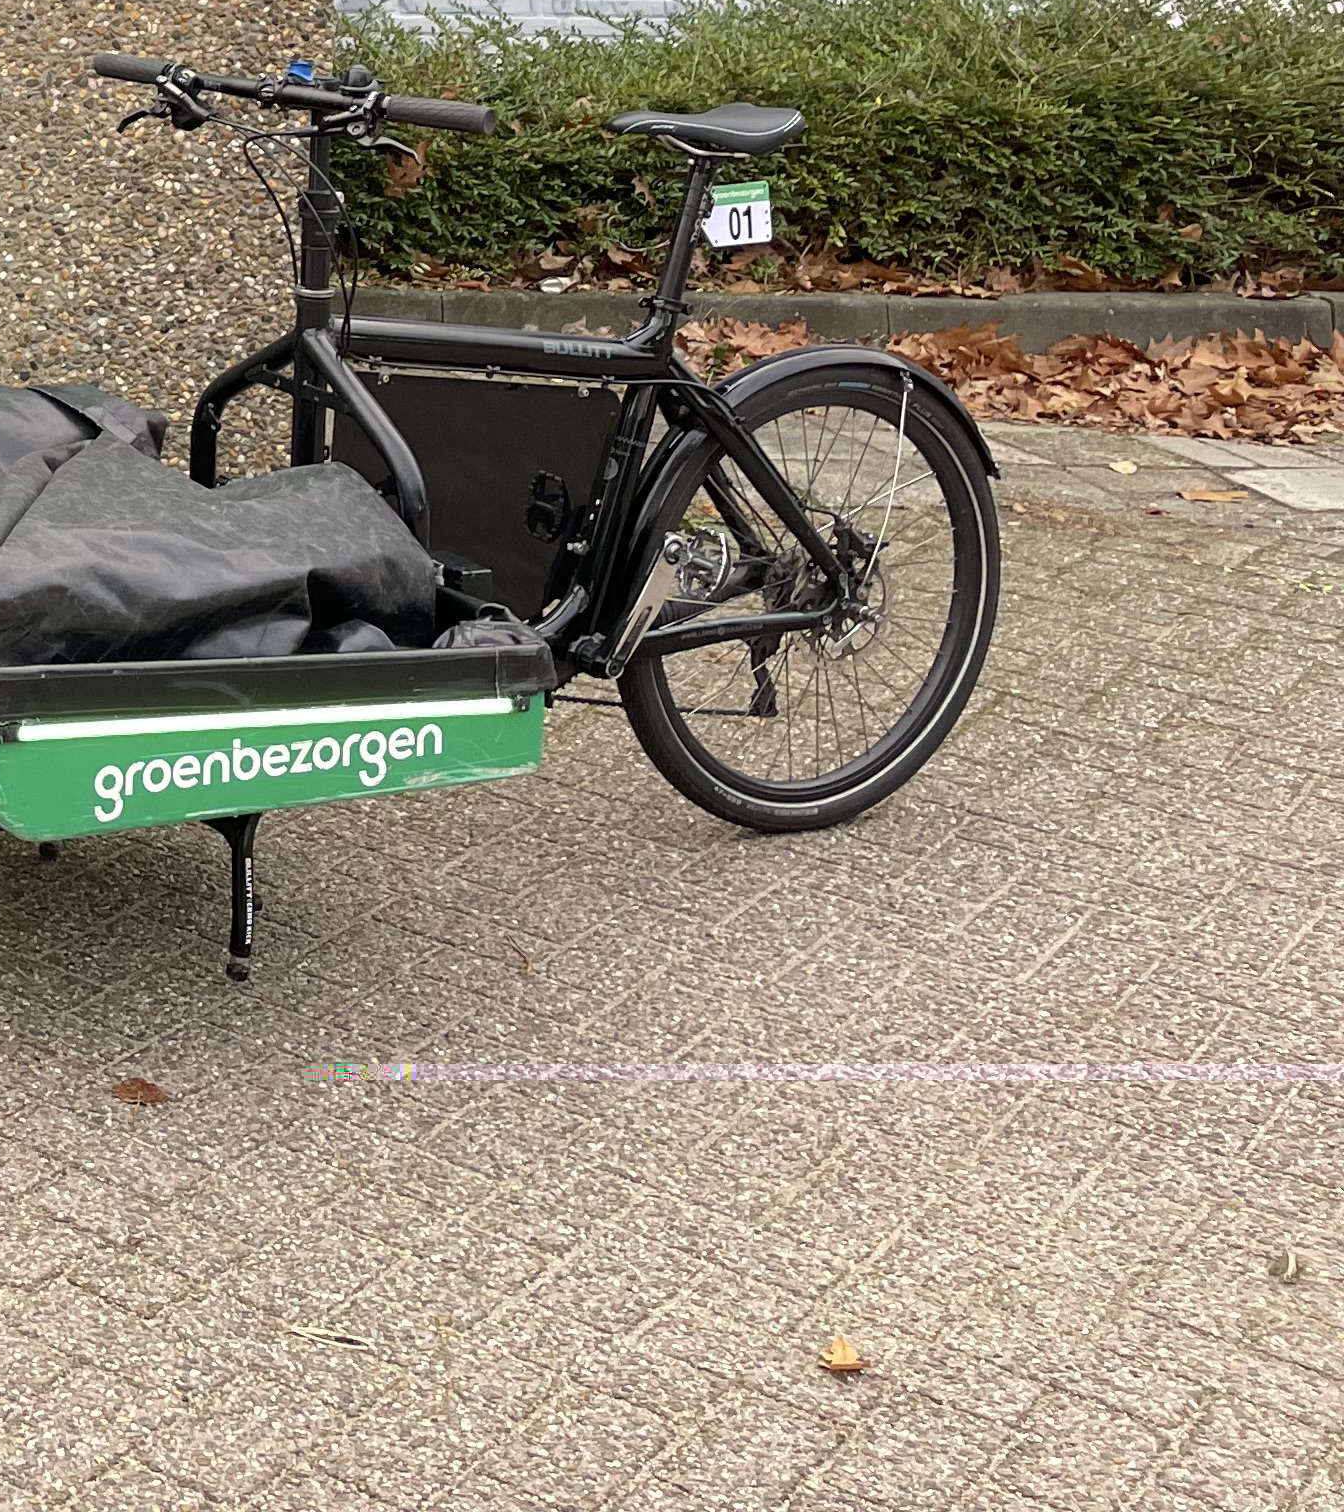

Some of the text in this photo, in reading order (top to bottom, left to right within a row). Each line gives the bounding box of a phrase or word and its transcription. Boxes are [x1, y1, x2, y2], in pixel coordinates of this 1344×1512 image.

[728, 205, 754, 241] 01
[543, 340, 612, 359] BULLITT
[94, 723, 443, 822] groenbezorgen
